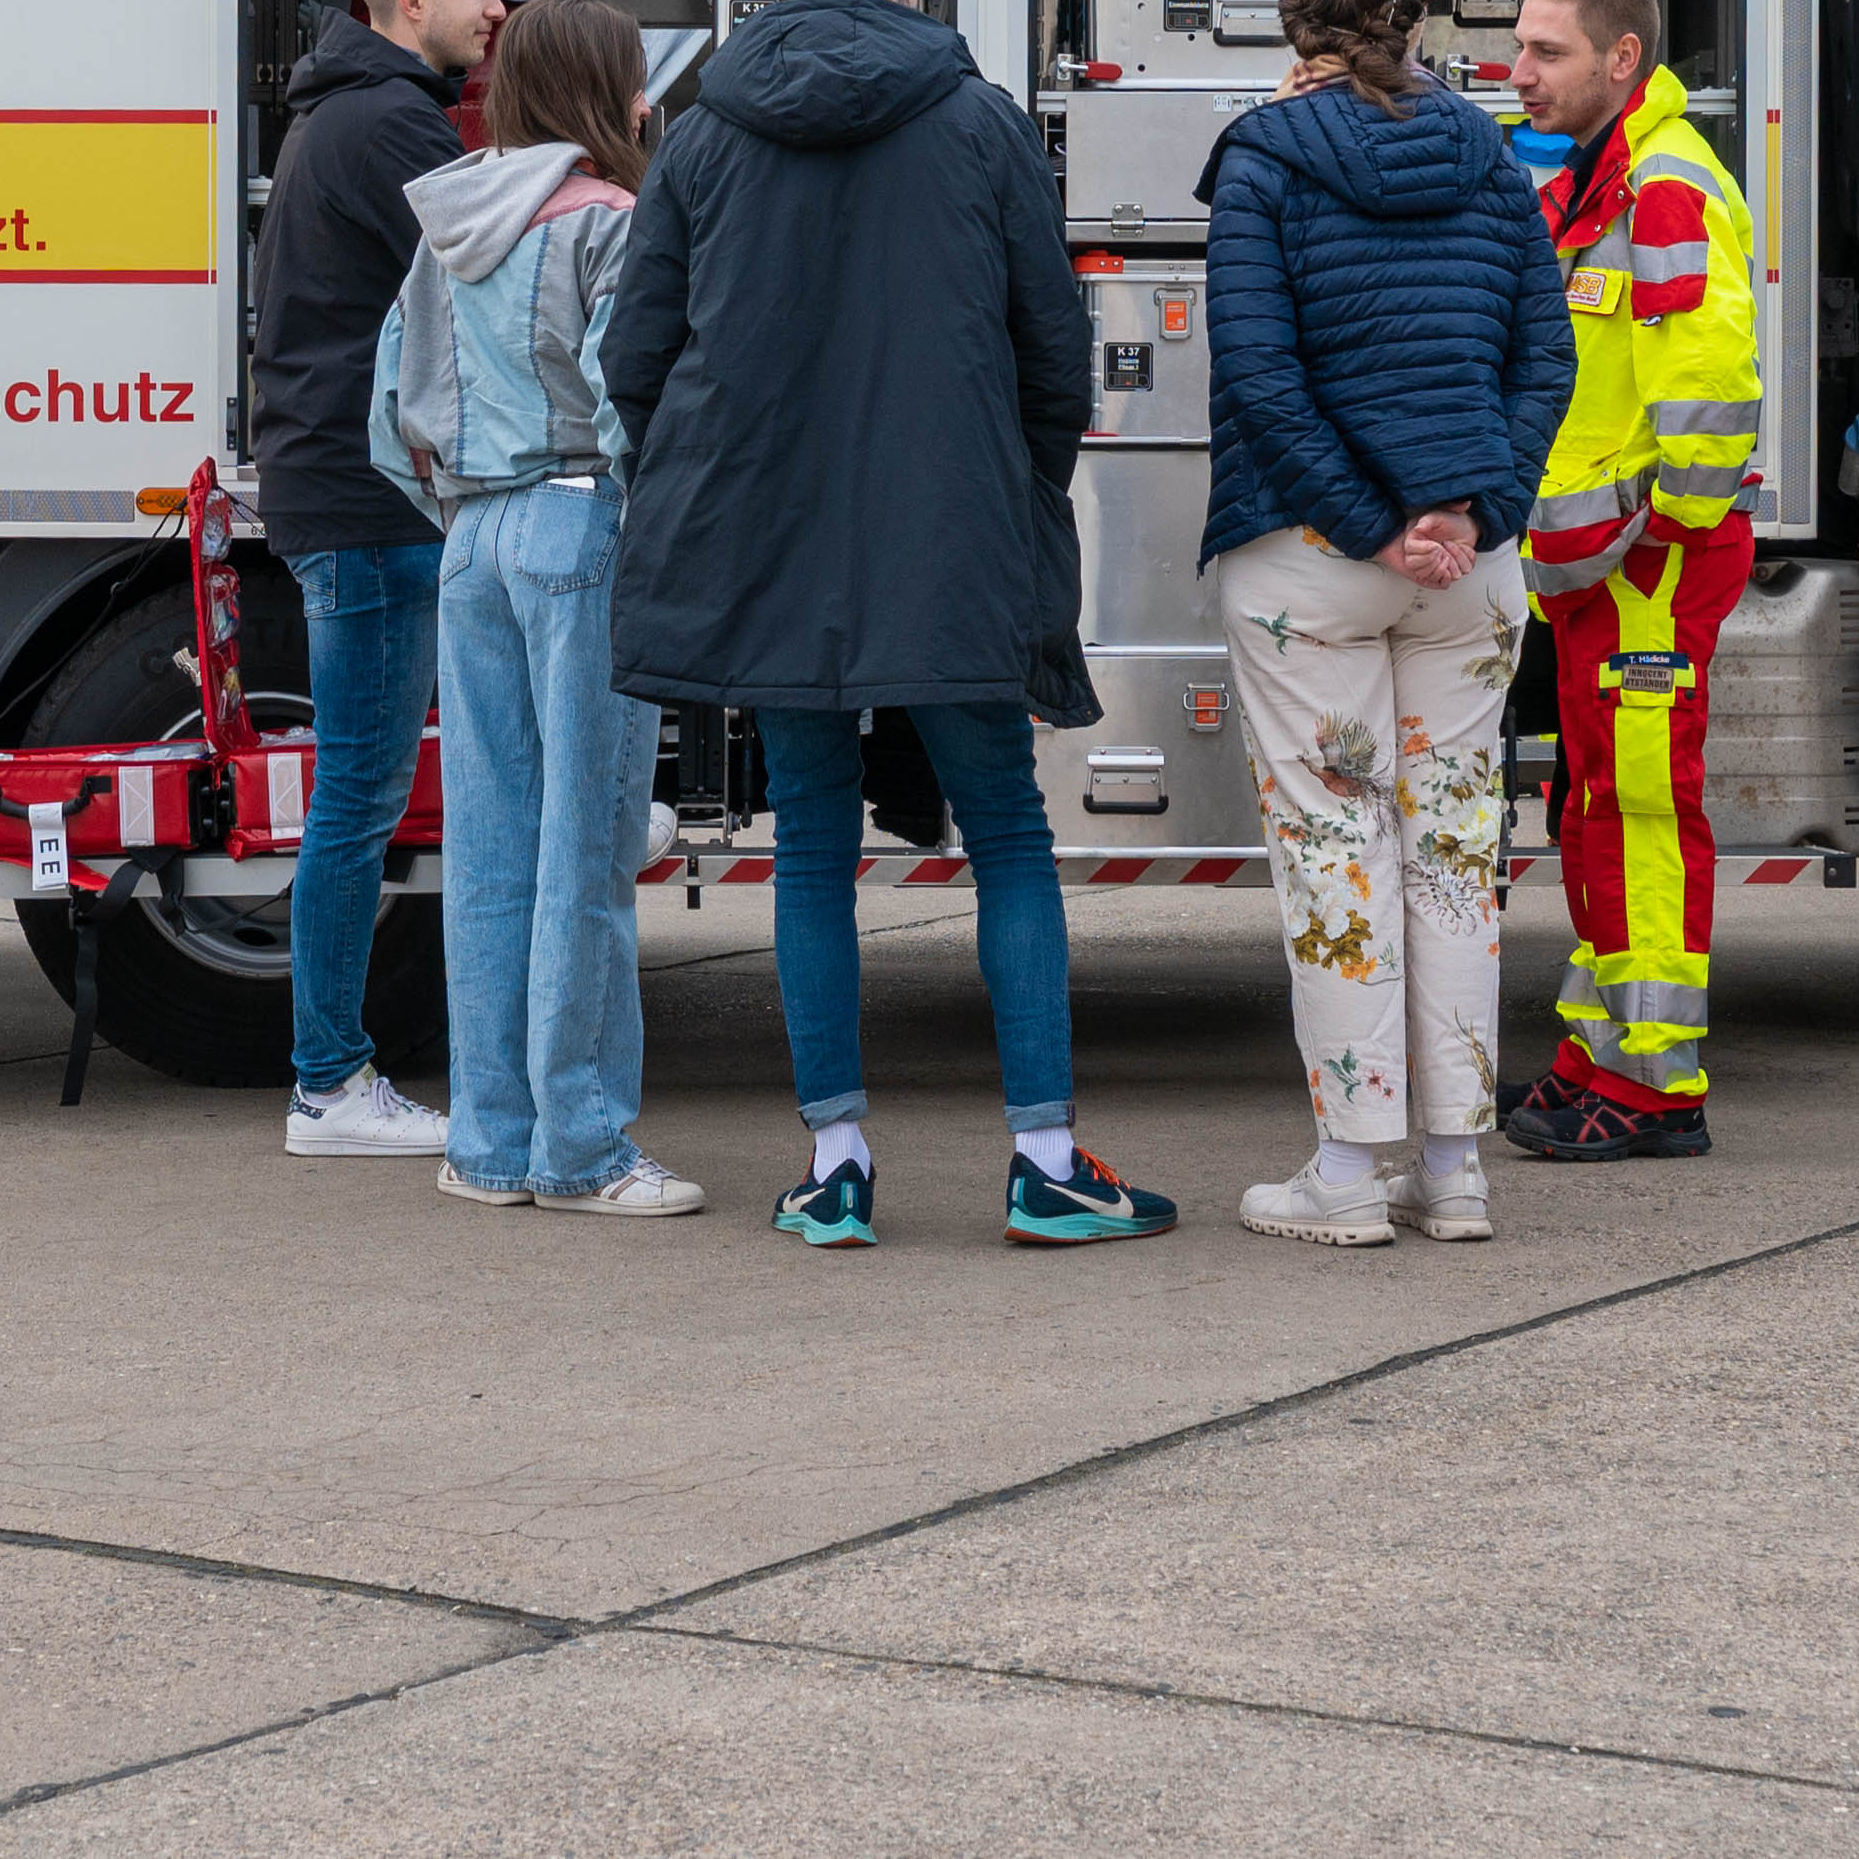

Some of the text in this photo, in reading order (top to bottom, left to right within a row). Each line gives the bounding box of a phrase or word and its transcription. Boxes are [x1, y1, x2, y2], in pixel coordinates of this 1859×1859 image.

[742, 3, 751, 12] K
[1117, 347, 1140, 356] K 37
[1629, 655, 1637, 664] T.
[1628, 668, 1668, 678] INNOCENT
[1624, 678, 1671, 689] BYSTANDER
